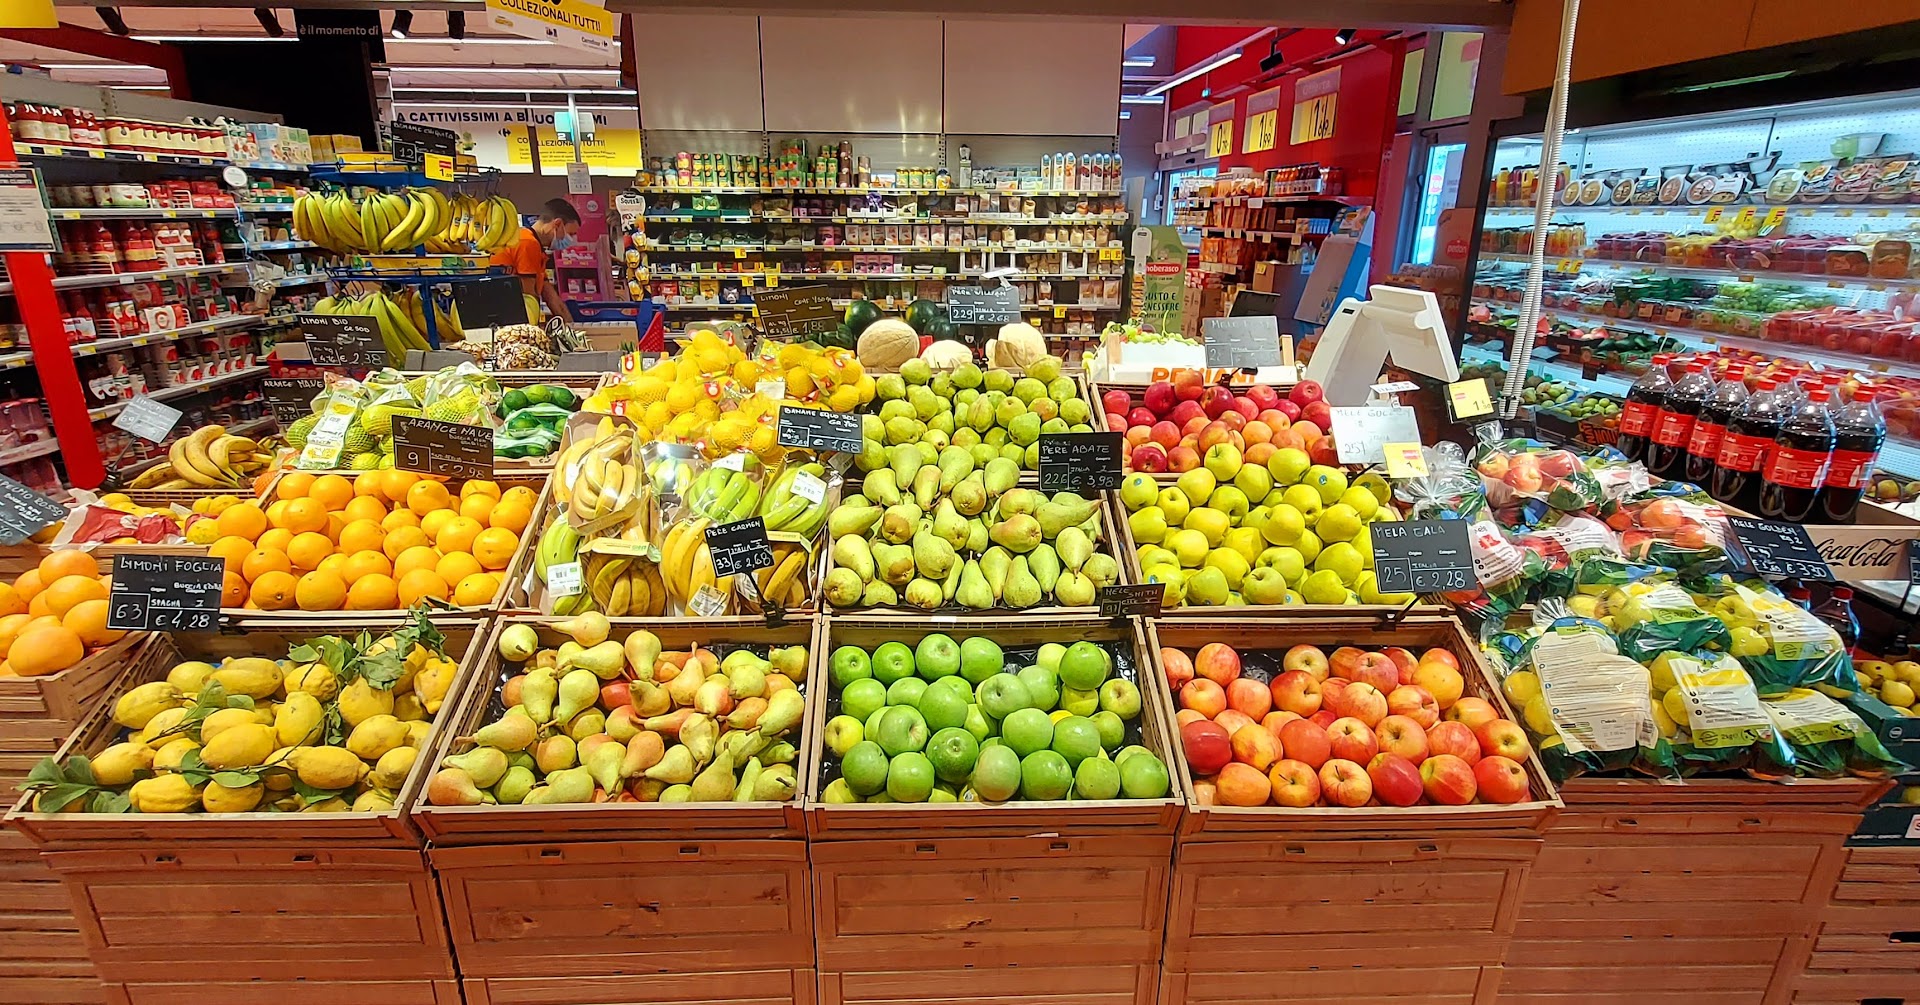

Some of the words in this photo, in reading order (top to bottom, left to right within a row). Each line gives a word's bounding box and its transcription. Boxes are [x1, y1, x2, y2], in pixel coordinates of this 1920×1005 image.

[300, 24, 306, 35] è
[308, 25, 314, 35] il
[316, 26, 367, 35] momento
[368, 25, 379, 35] di
[409, 112, 499, 122] CATTIVISSIMI
[504, 112, 513, 122] A
[557, 132, 566, 140] 2
[400, 147, 414, 158] 12
[760, 294, 788, 302] LIMONI
[953, 309, 973, 320] 229
[340, 354, 348, 362] €
[820, 412, 839, 420] EQUO
[842, 414, 858, 422] SOL
[408, 418, 457, 434] ARANCE
[813, 438, 824, 446] €
[832, 440, 860, 454] 1,88
[1042, 446, 1068, 454] PERE
[1072, 444, 1110, 454] ABATE
[408, 452, 418, 466] 9
[438, 464, 448, 472] €
[450, 465, 484, 479] 2,98
[1044, 473, 1068, 484] 226
[1072, 476, 1082, 486] €
[1087, 475, 1114, 488] 3,98
[706, 528, 728, 538] PERE
[730, 520, 760, 532] CARMEN
[1374, 526, 1408, 538] MELA
[1412, 526, 1446, 537] GALA
[1758, 522, 1798, 536] GOLDEN
[120, 556, 168, 572] LIMONI
[175, 560, 222, 572] FOGLIA
[716, 557, 732, 570] 33
[734, 560, 742, 570] €
[746, 552, 770, 568] 2,68
[1384, 566, 1406, 583] 25
[1786, 562, 1796, 574] €
[1416, 576, 1426, 586] €
[1432, 570, 1466, 590] 2,28
[151, 598, 180, 608] SPAGNA
[116, 604, 142, 620] 63
[156, 615, 166, 626] €
[172, 610, 210, 630] 4,28
